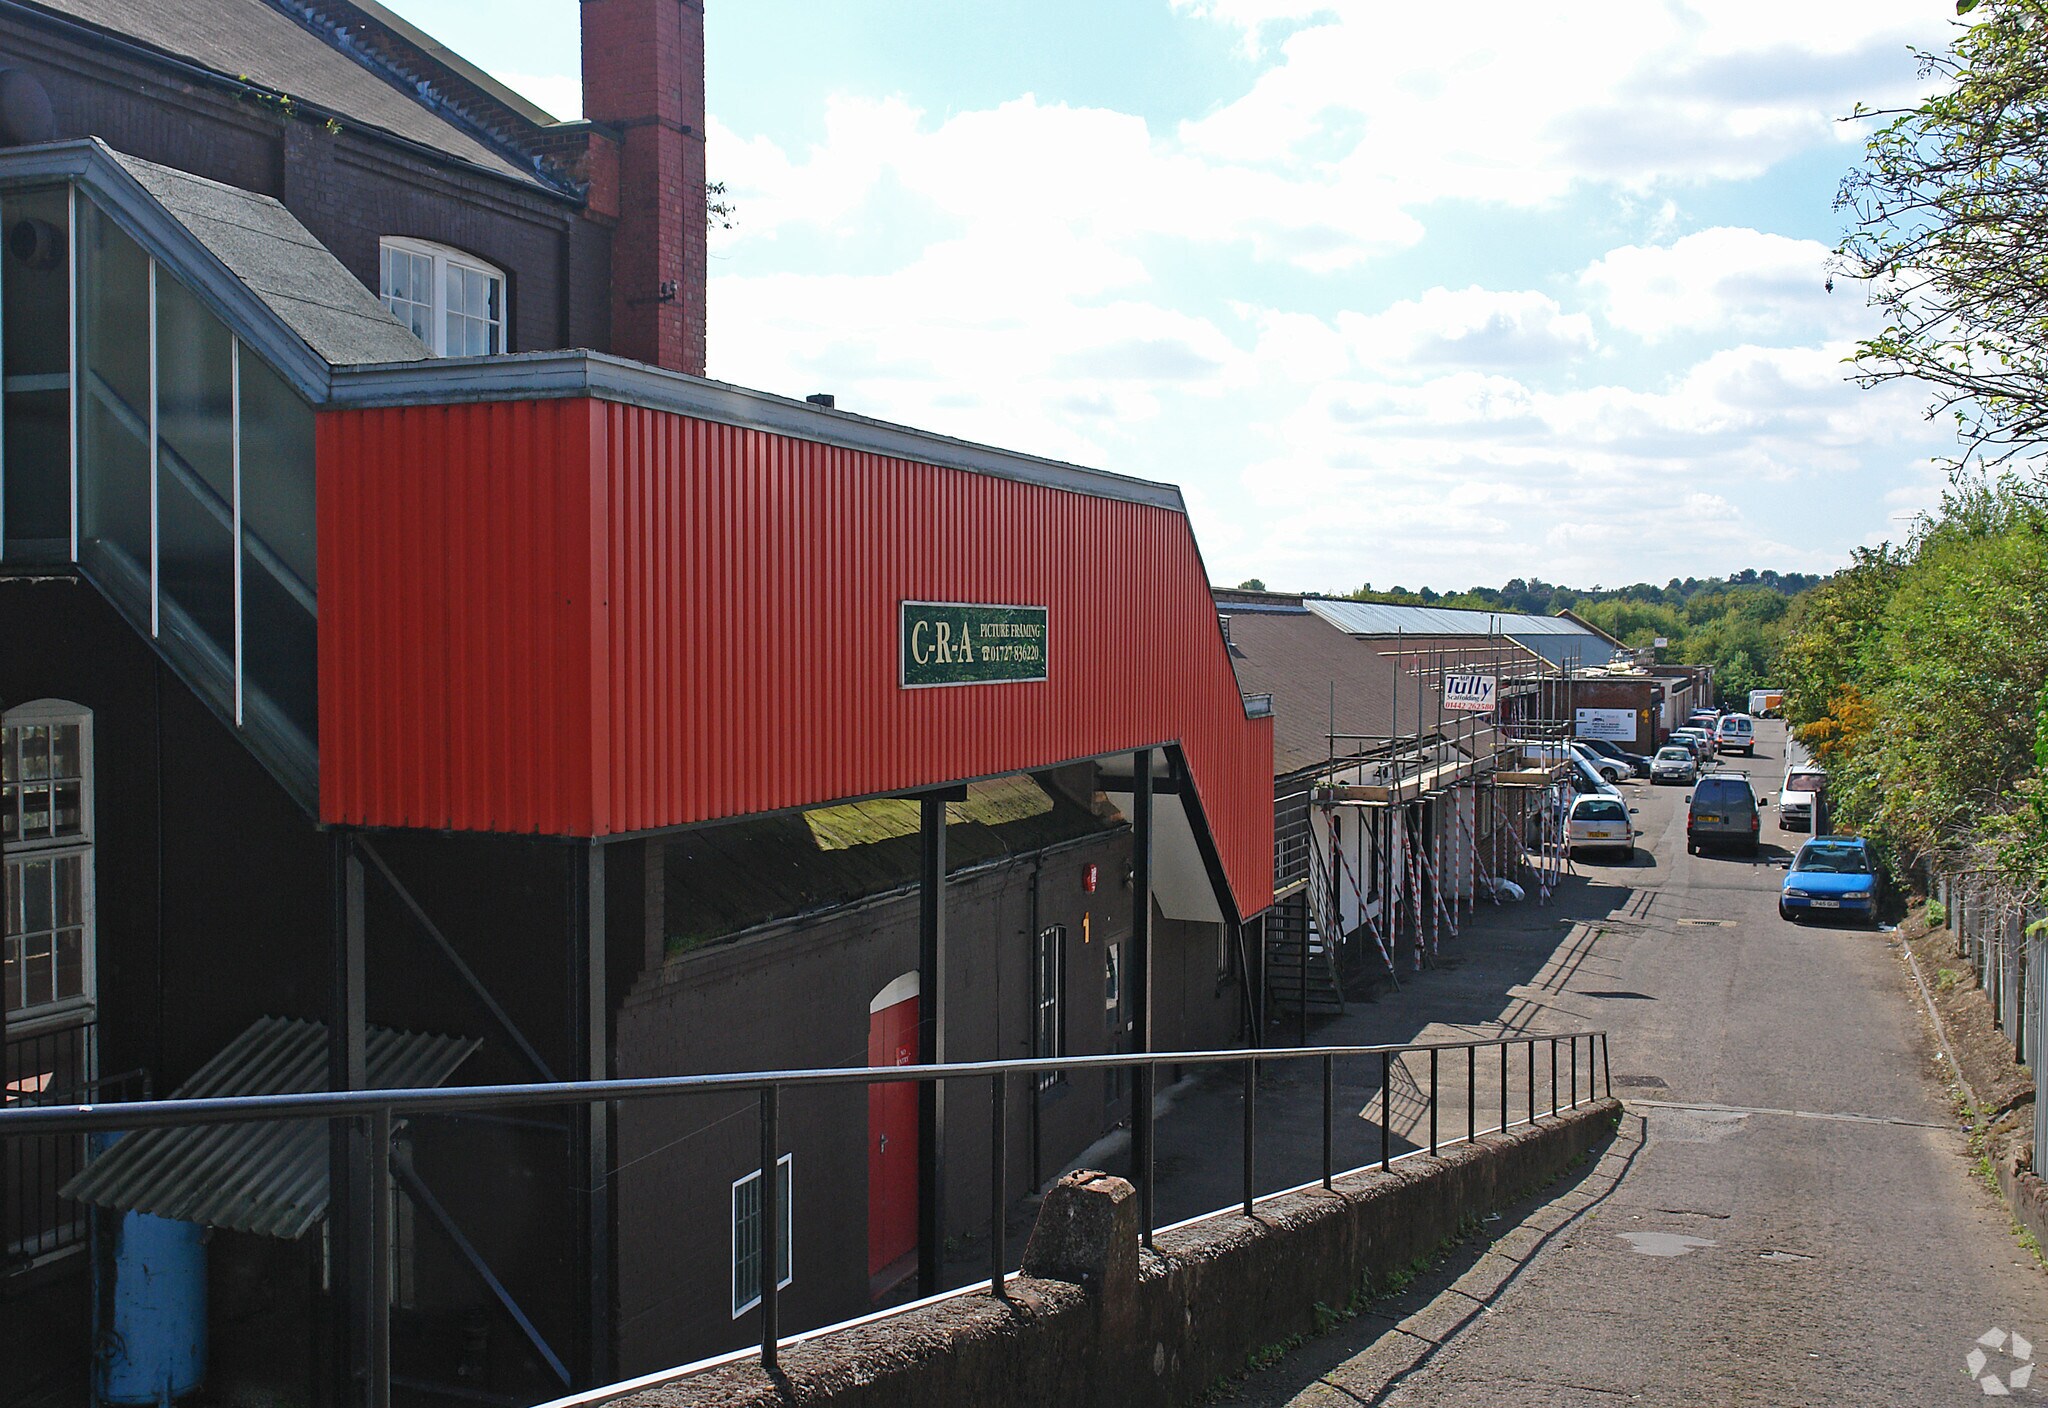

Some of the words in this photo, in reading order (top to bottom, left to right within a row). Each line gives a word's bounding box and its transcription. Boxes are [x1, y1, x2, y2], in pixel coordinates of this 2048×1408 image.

[980, 623, 1009, 638] PICTURE
[1010, 623, 1040, 638] FRAMING
[991, 645, 1012, 661] 01727
[1013, 643, 1039, 661] 836220
[1447, 676, 1494, 701] Tully
[1445, 701, 1466, 709] 01442
[1468, 702, 1494, 710] 262580
[1447, 694, 1480, 702] Scaffolding
[1641, 709, 1649, 718] 4
[1083, 911, 1090, 943] 1
